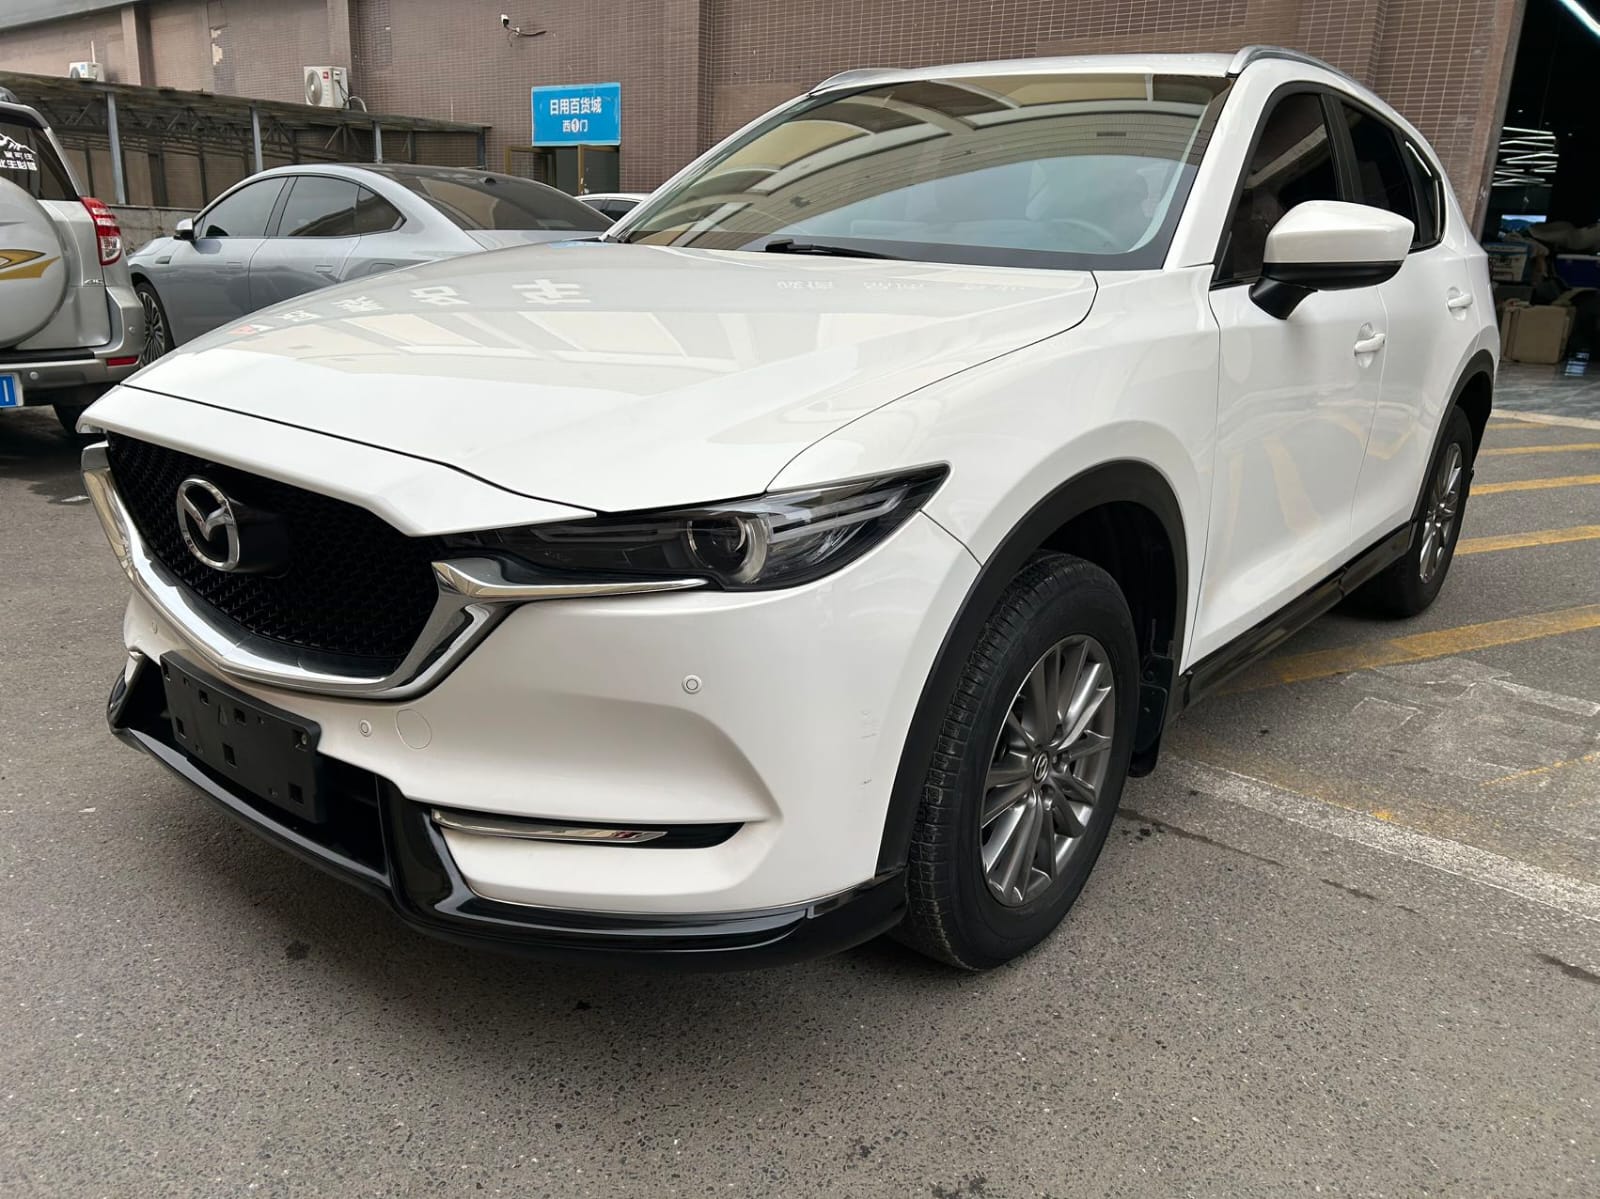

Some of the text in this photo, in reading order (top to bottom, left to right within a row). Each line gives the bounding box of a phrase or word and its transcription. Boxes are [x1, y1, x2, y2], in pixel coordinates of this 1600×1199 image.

[550, 97, 602, 115] 日用百货城
